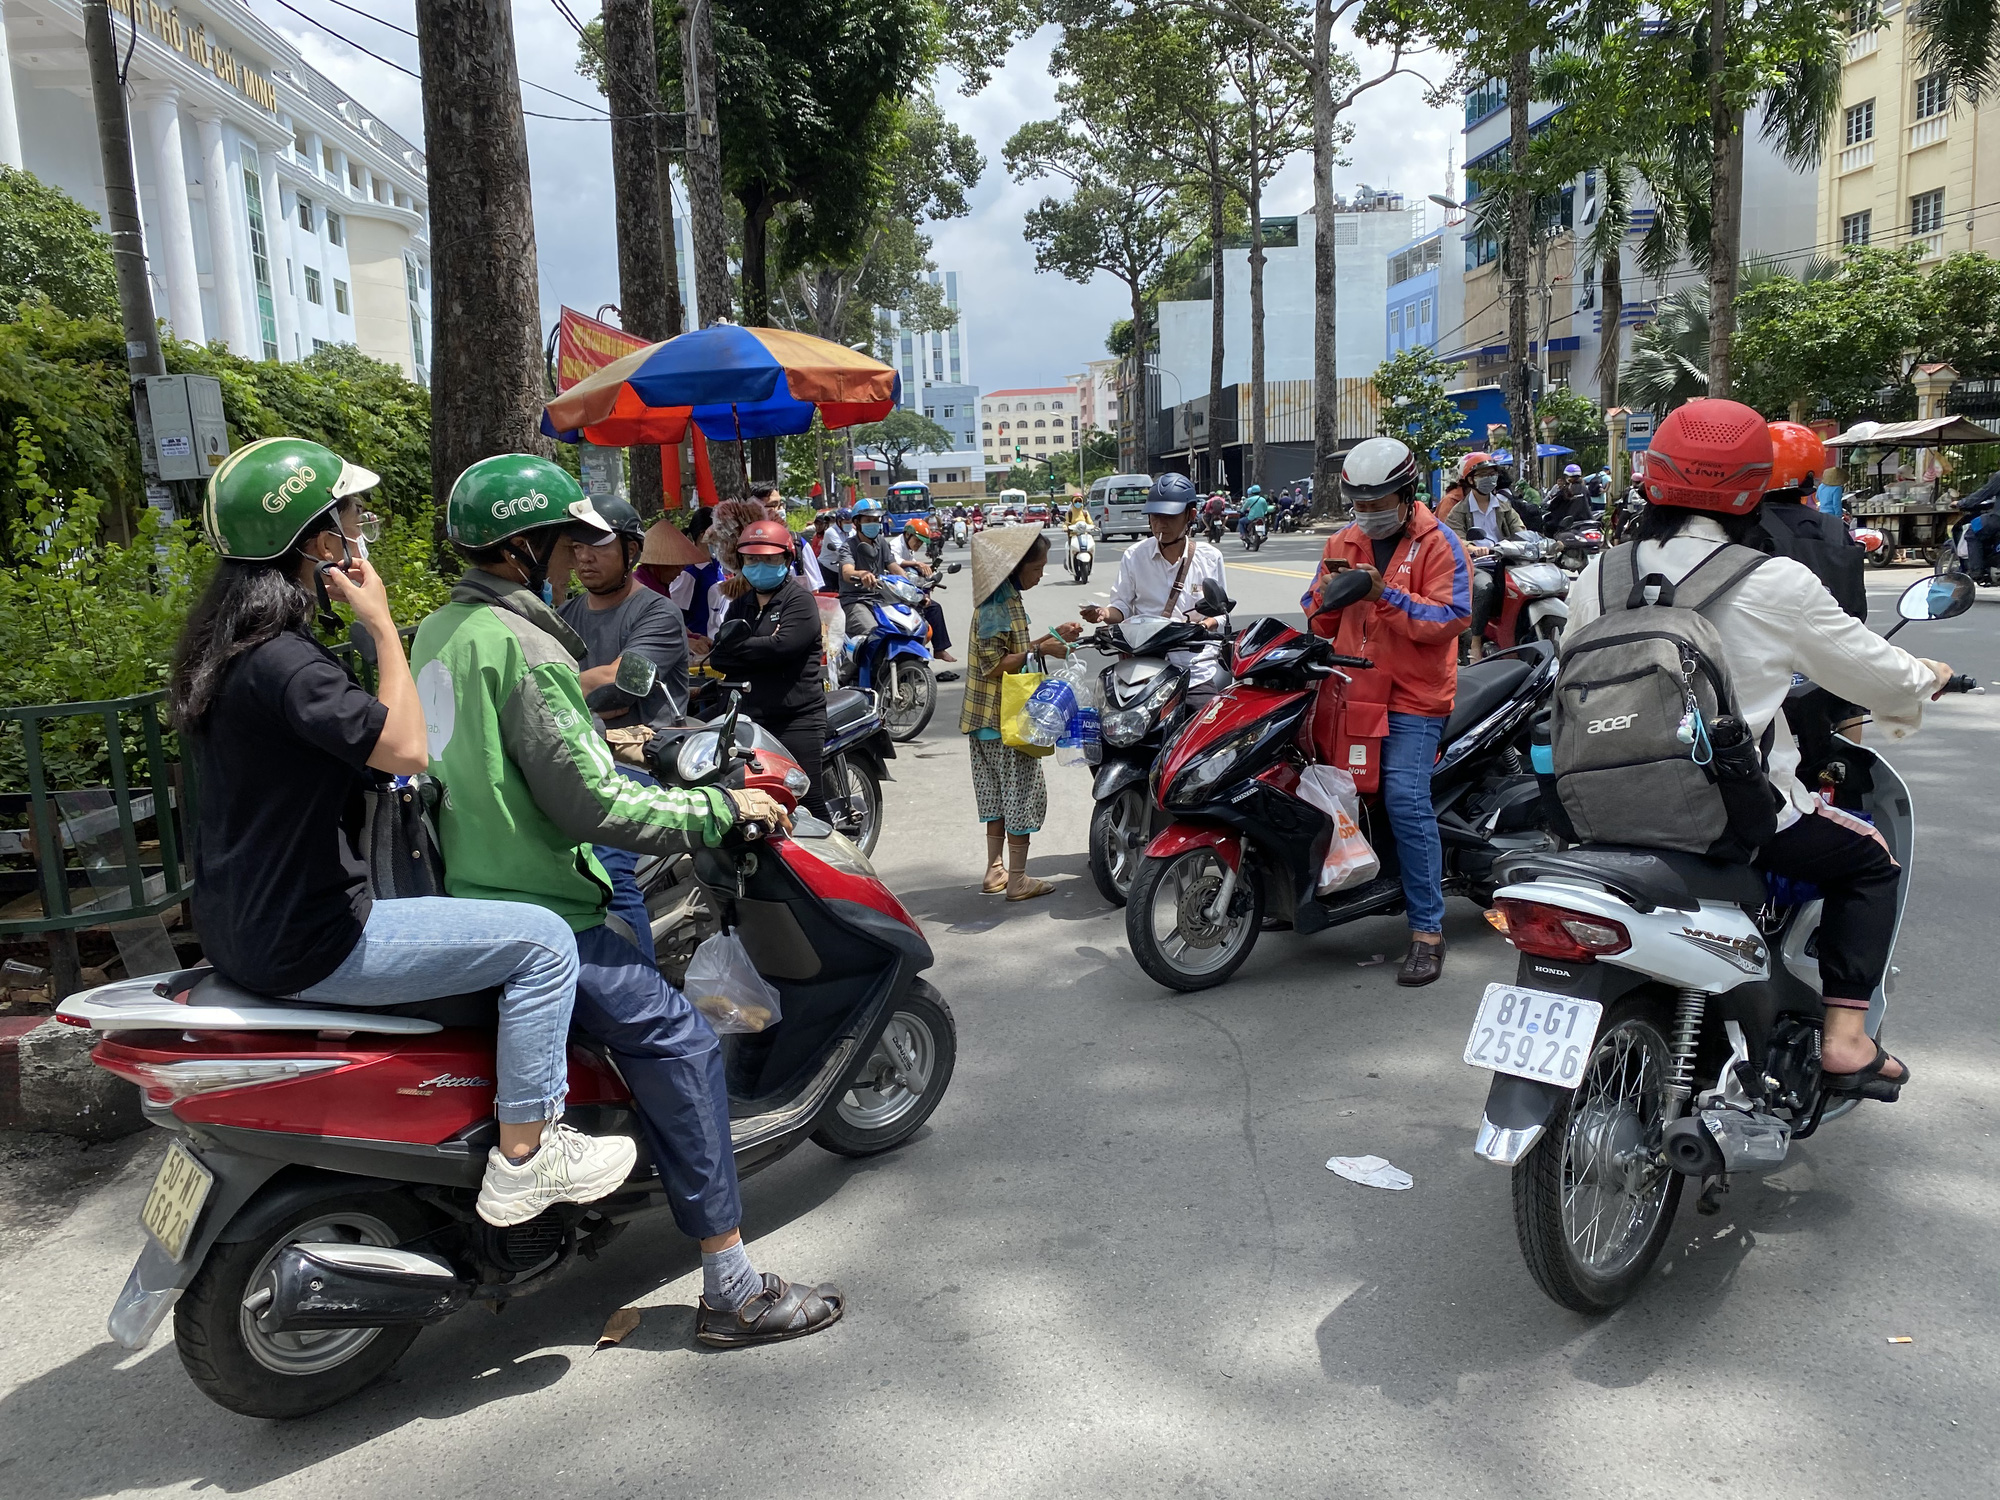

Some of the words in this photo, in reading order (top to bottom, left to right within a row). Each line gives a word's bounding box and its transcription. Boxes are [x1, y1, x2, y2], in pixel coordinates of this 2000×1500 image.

[149, 2, 184, 52] PHỐ
[187, 24, 210, 68] HỒ
[213, 46, 240, 89] CHÍ
[242, 65, 277, 113] MINH
[262, 464, 316, 514] Grab
[491, 488, 549, 520] Grab
[1398, 564, 1411, 575] No
[554, 708, 580, 730] Gr
[1587, 713, 1639, 734] acer
[1348, 766, 1367, 775] Now
[1534, 965, 1572, 978] HONDA
[1496, 993, 1580, 1039] 81-G1
[1473, 1027, 1581, 1079] 259.26
[418, 1072, 492, 1088] Attila
[162, 1149, 202, 1210] 50-N1
